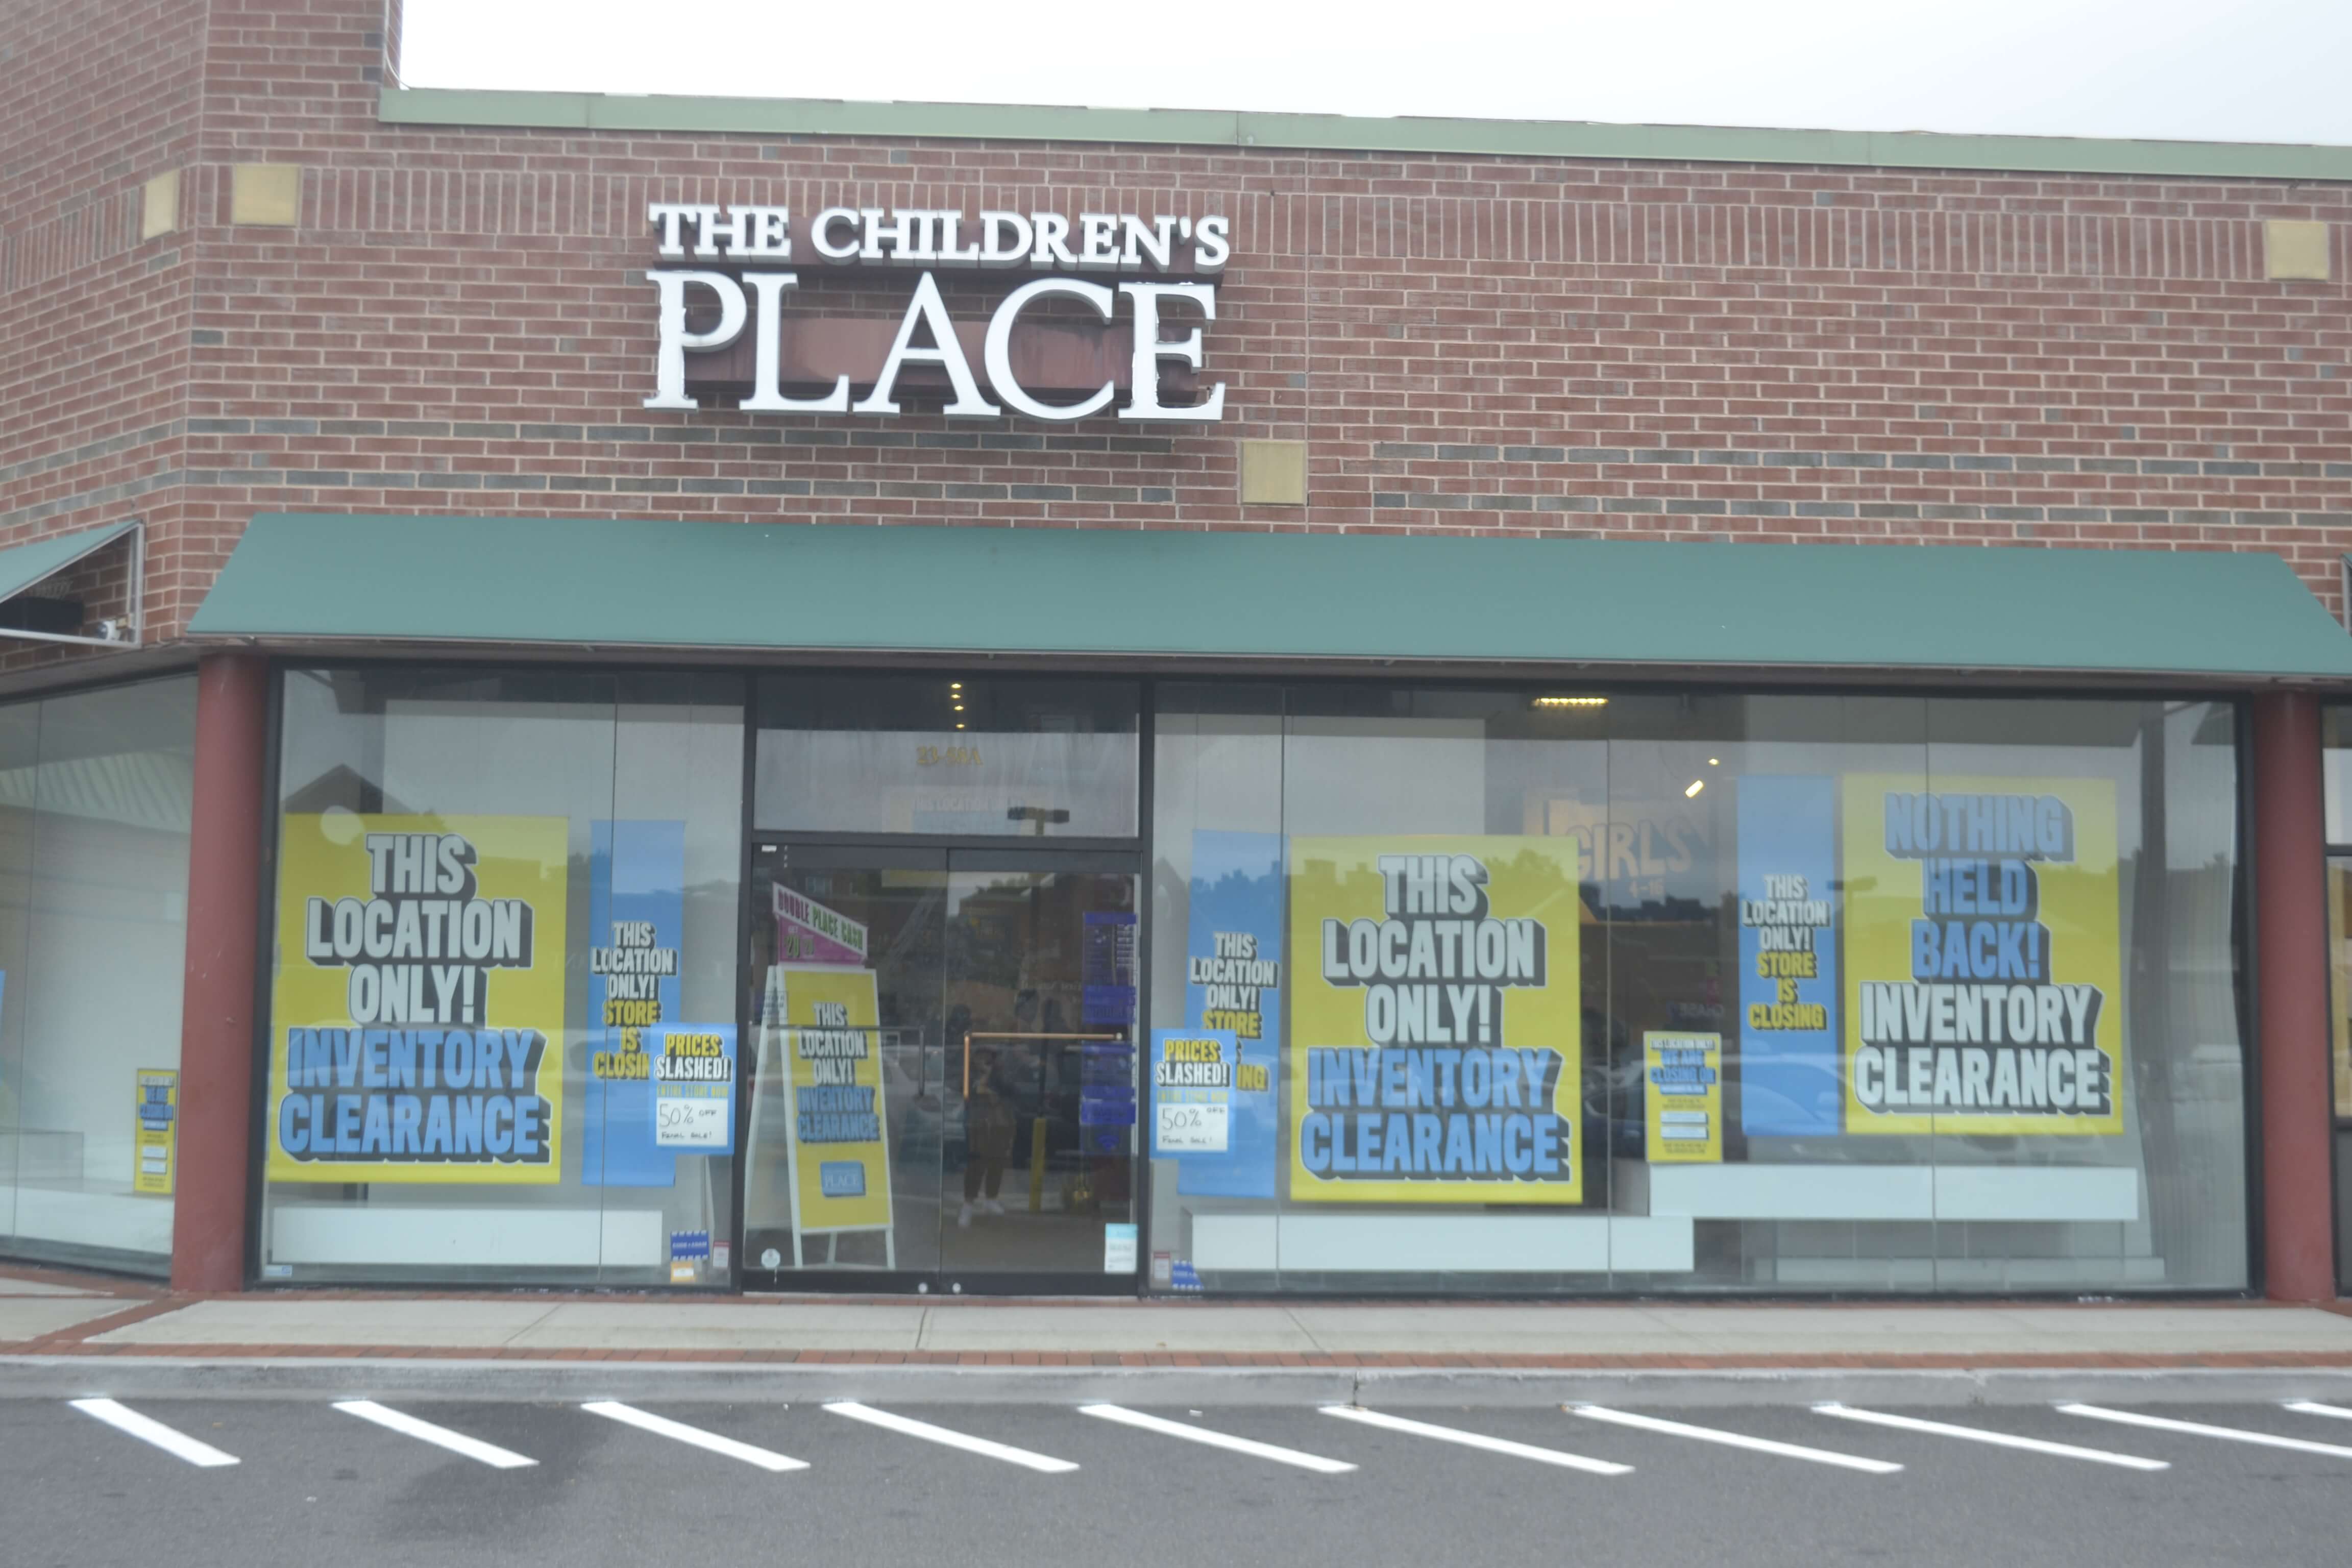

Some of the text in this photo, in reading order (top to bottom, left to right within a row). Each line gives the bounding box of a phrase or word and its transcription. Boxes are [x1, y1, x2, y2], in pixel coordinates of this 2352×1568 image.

[648, 203, 1230, 274] THE CHILDREN'S
[643, 271, 1226, 421] PLACE
[1884, 793, 2067, 857] NOTHING
[1566, 818, 1692, 881] GIRLS
[366, 834, 472, 896] THIS
[1379, 854, 1483, 916] THIS
[1764, 874, 1807, 898] THIS
[1924, 858, 2031, 916] HELD
[777, 888, 809, 924] DOUBLE
[812, 905, 838, 939] PLACE
[841, 920, 863, 951] CASH
[1742, 900, 1829, 925] LOCATION
[307, 898, 528, 962] LOCATION
[613, 922, 653, 947] THIS
[1761, 926, 1812, 950] ONLY!
[1214, 933, 1256, 957] THIS
[1323, 919, 1540, 982] LOCATION
[1912, 919, 2043, 981] BACK!
[591, 947, 675, 973] LOCATION
[1190, 958, 1276, 985] LOCATION
[1757, 951, 1816, 976] STORE
[350, 964, 480, 1023] ONLY!
[607, 975, 656, 999] ONLY!
[1207, 985, 1258, 1010] ONLY!
[1777, 978, 1796, 1002] IS
[603, 1000, 659, 1025] STORE
[814, 1003, 845, 1026] THIS
[1203, 1010, 1259, 1038] STORE
[1367, 985, 1496, 1044] ONLY!
[1749, 1004, 1825, 1028] CLOSING
[1860, 982, 2097, 1044] INVENTORY
[621, 1026, 639, 1051] IS
[666, 1034, 721, 1056] PRICES
[799, 1030, 866, 1057] LOCATION
[1164, 1039, 1220, 1062] PRICES
[287, 1027, 540, 1089] INVENTORY
[593, 1051, 649, 1079] CLOSIN
[655, 1057, 729, 1080] SLASHED!
[814, 1058, 853, 1085] ONLY!
[1156, 1062, 1229, 1086] SLASHED!
[1307, 1048, 1557, 1109] INVENTORY
[1854, 1046, 2104, 1111] CLEARANCE
[796, 1086, 873, 1112] INVENTORY
[280, 1094, 545, 1159] CLEARANCE
[659, 1103, 694, 1128] 50%
[797, 1112, 880, 1141] CLEARANCE
[1162, 1107, 1202, 1130] 50%
[1301, 1113, 1565, 1178] CLEARANCE
